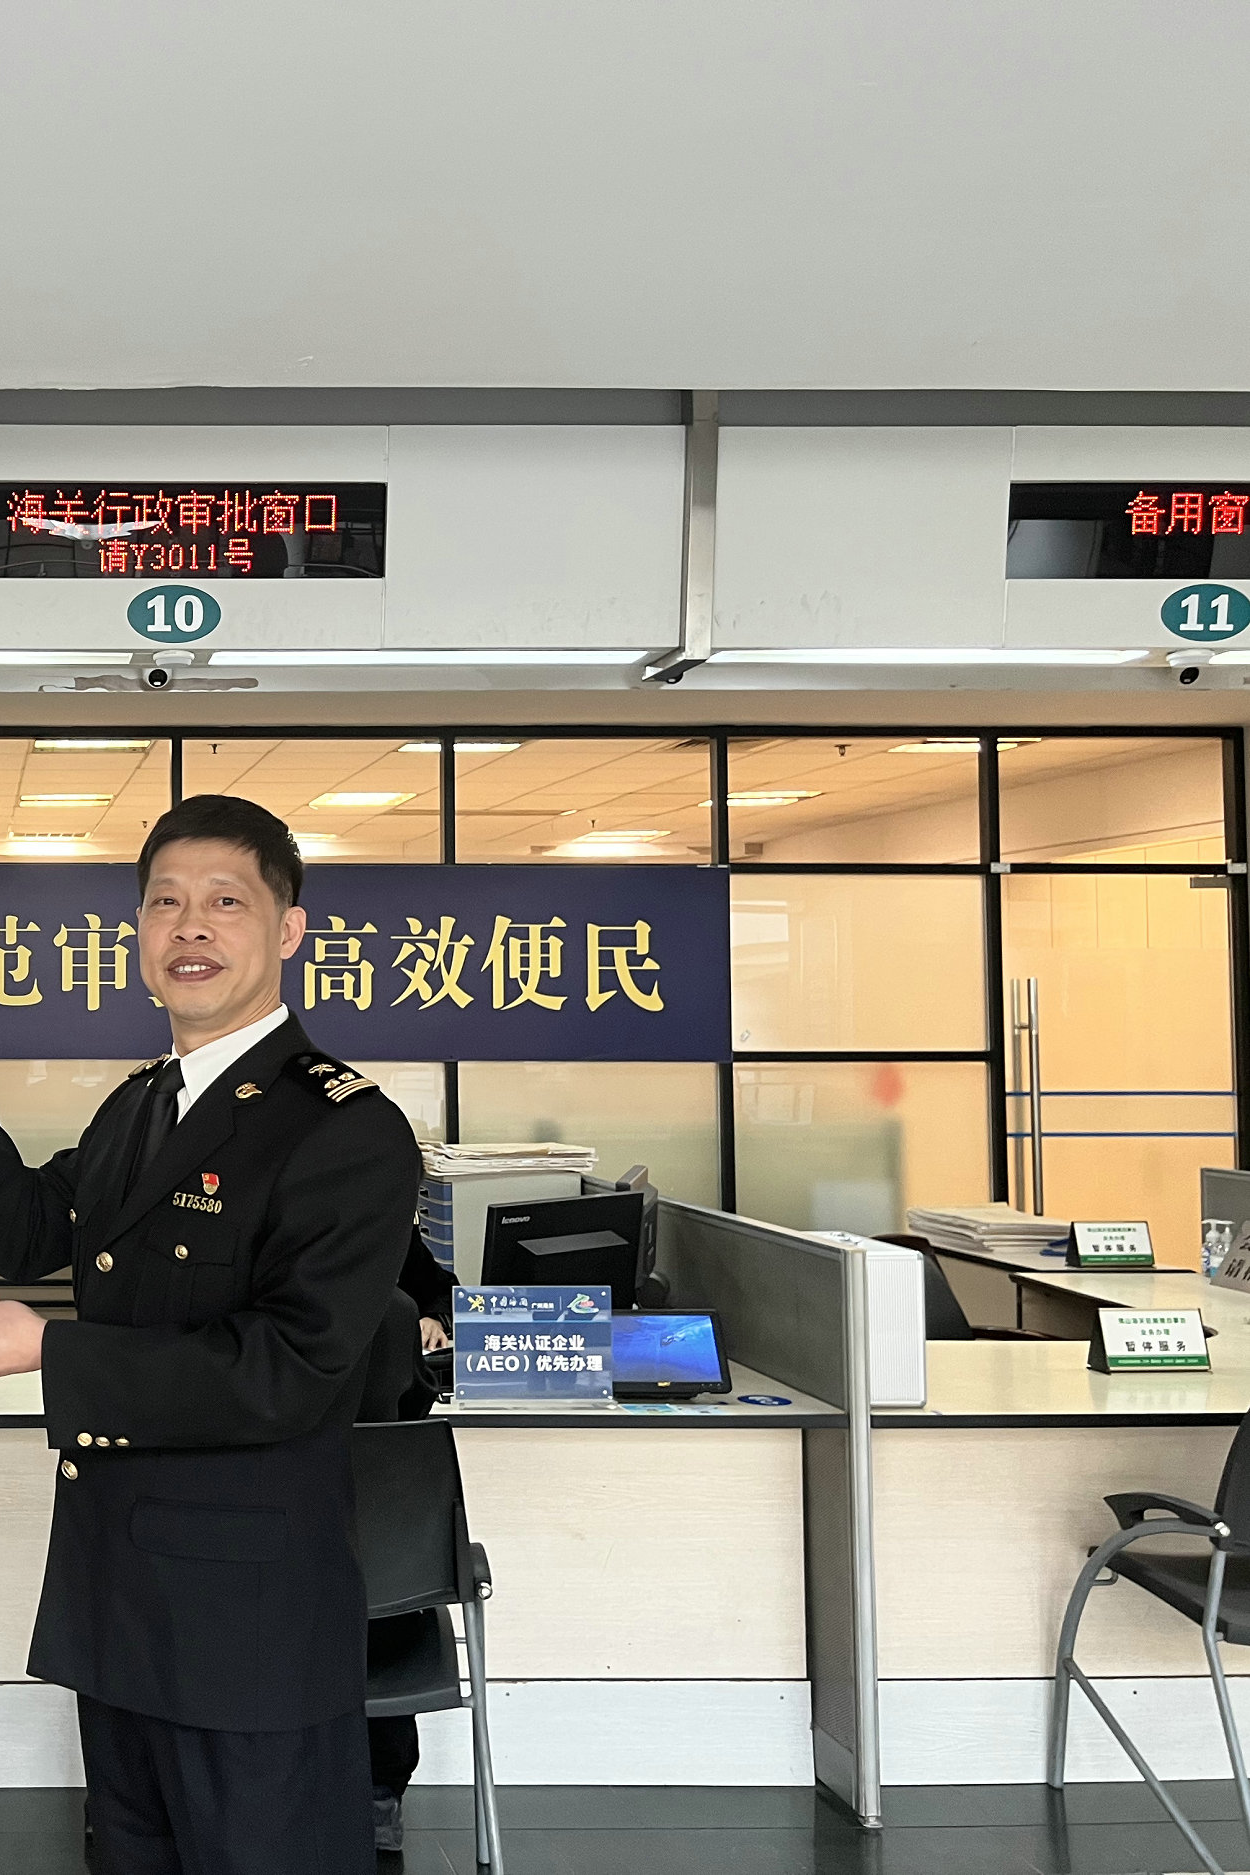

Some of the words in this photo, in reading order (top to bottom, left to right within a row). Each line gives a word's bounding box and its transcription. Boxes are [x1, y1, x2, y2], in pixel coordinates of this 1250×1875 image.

[7, 489, 338, 535] 海关行政审批窗口
[1125, 490, 1250, 535] 备用窗
[99, 538, 254, 572] 请Y3011号
[146, 594, 206, 634] 10
[1179, 593, 1234, 631] 11
[303, 914, 664, 1013] 高效便民
[172, 1191, 222, 1214] 5175580
[484, 1335, 585, 1352] 海关认证企业
[1125, 1340, 1187, 1352] 暂停服务
